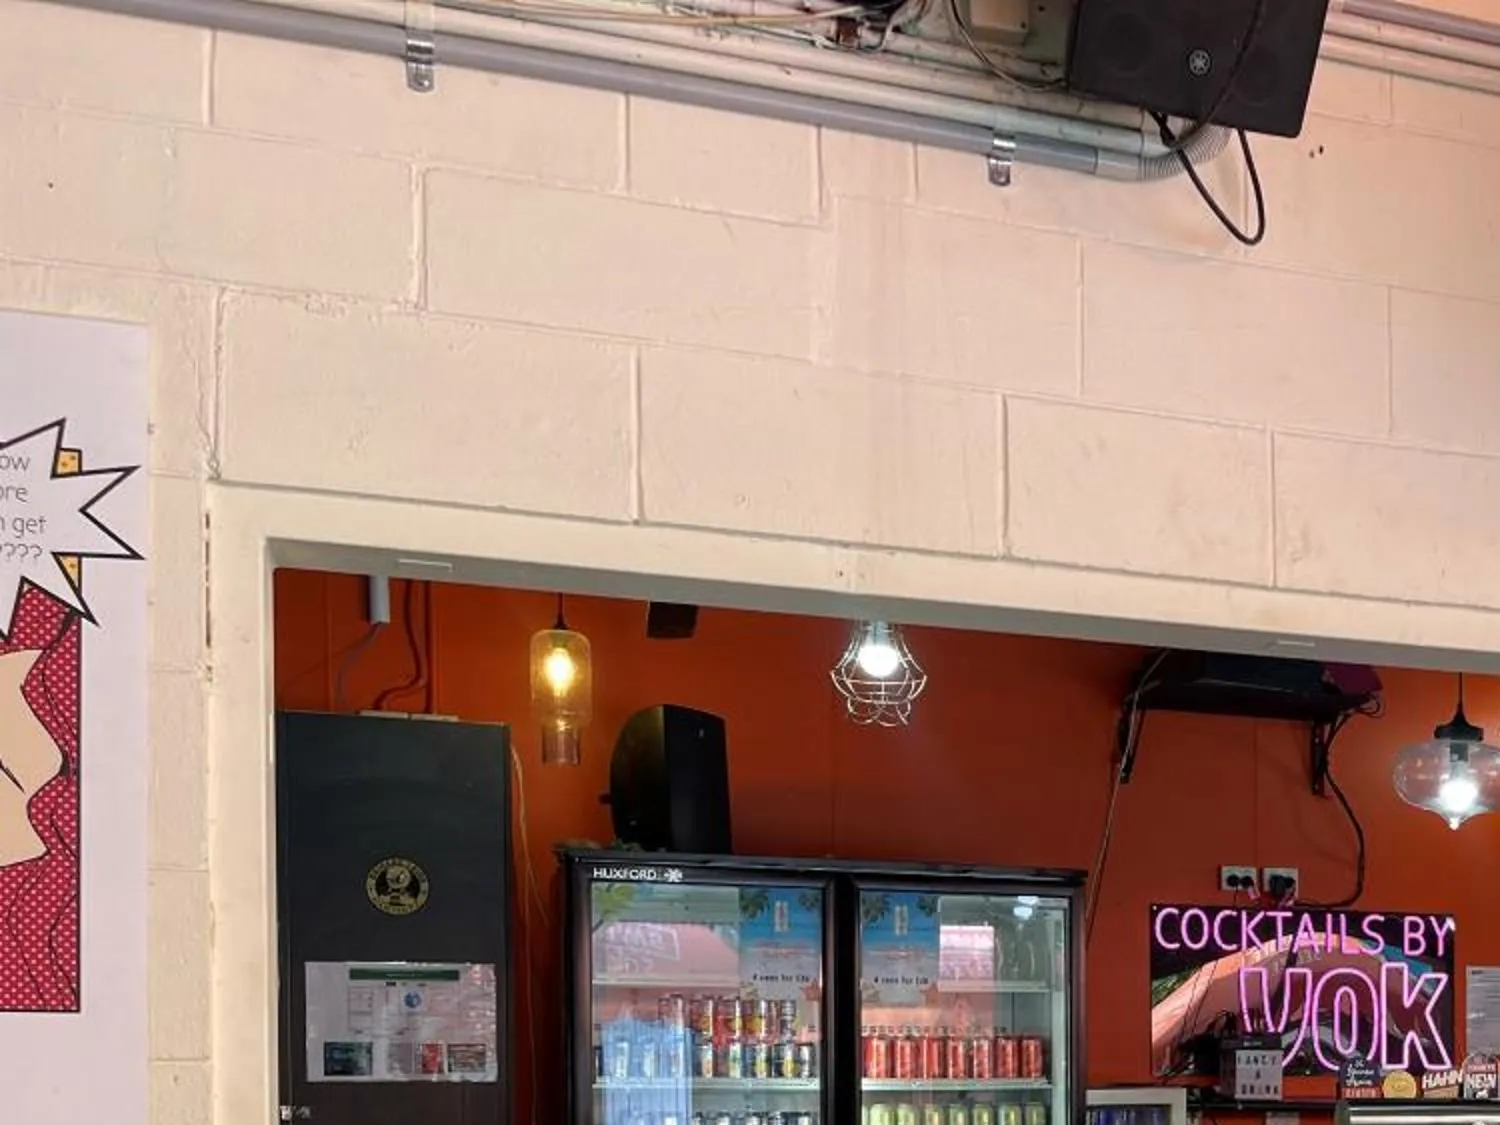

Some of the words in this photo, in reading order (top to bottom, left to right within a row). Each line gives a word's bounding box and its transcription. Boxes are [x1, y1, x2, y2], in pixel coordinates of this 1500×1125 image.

[12, 515, 46, 539] get
[593, 867, 656, 881] HUXFORD
[1154, 907, 1386, 955] COCKTAILS
[1403, 914, 1455, 957] BY
[1239, 961, 1453, 1070] VOK
[1421, 1069, 1463, 1089] HAHN
[1464, 1073, 1497, 1089] NEW
